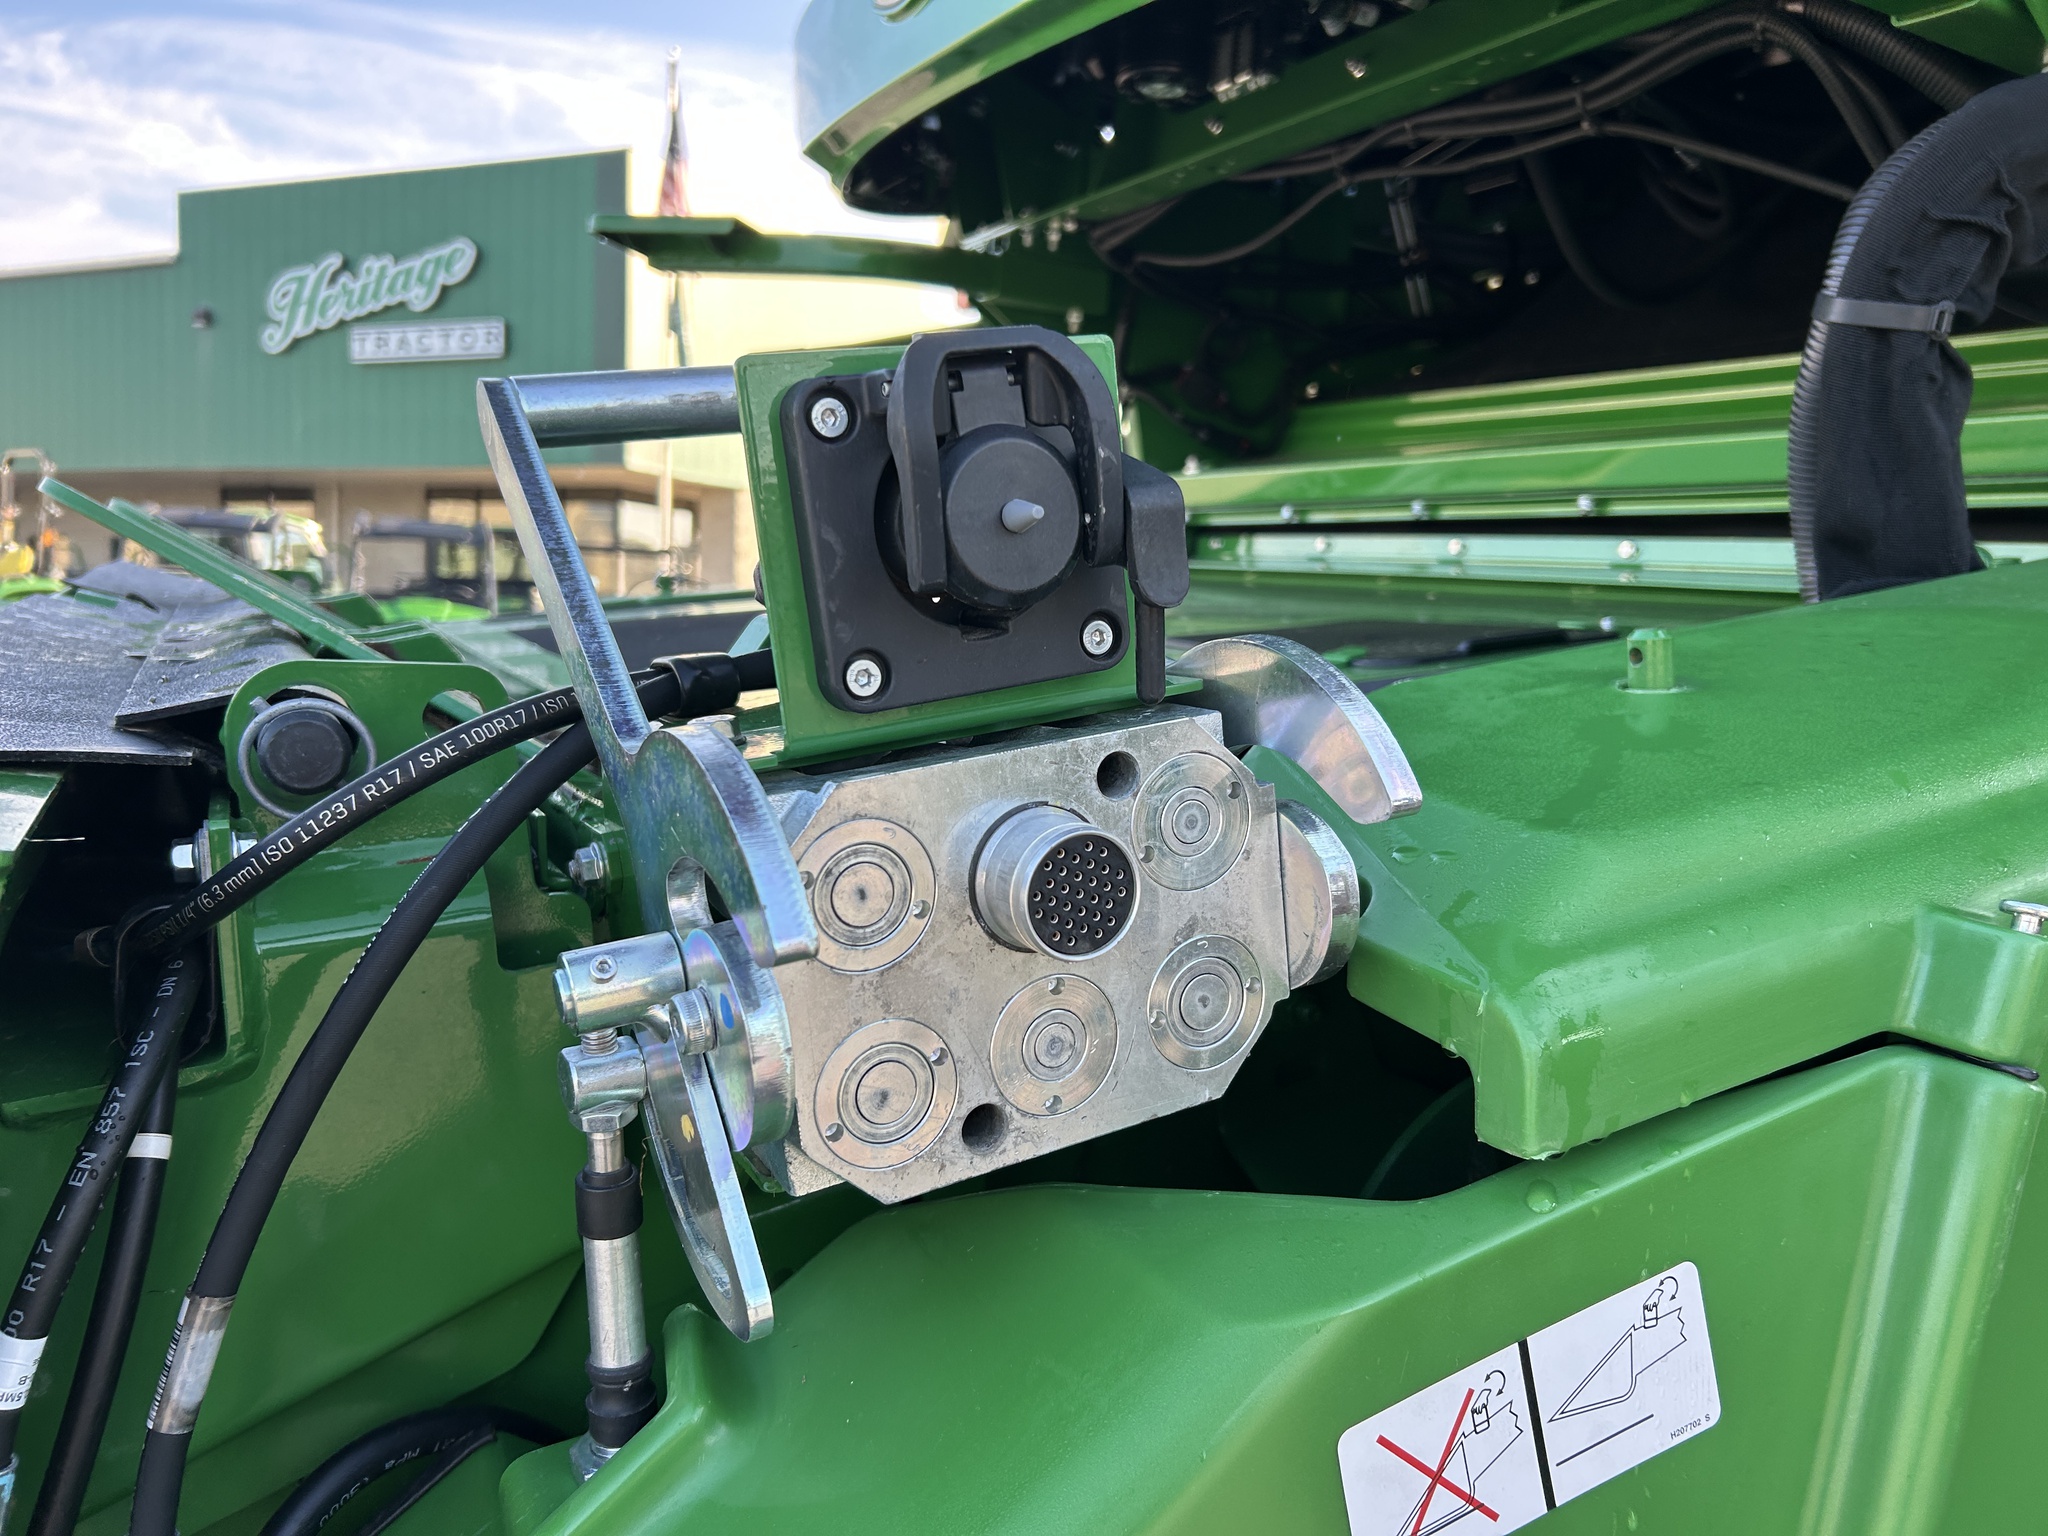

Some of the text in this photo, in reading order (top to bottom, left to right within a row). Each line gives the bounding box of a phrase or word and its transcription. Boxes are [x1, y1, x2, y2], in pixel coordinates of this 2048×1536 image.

[262, 239, 477, 354] Heritage
[353, 329, 501, 352] TRACTOR
[197, 885, 226, 912] (6.3
[261, 836, 295, 866] ISO
[295, 794, 357, 844] 11237
[362, 768, 402, 802] R17
[419, 740, 459, 769] SAE
[460, 709, 526, 749] 100R17
[21, 1238, 54, 1292] R17
[68, 1151, 98, 1187] EN
[95, 1086, 127, 1134] 857
[125, 1030, 154, 1068] 1SC
[157, 977, 178, 997] DN
[168, 959, 184, 969] 6
[1670, 1413, 1711, 1440] H207702 S
